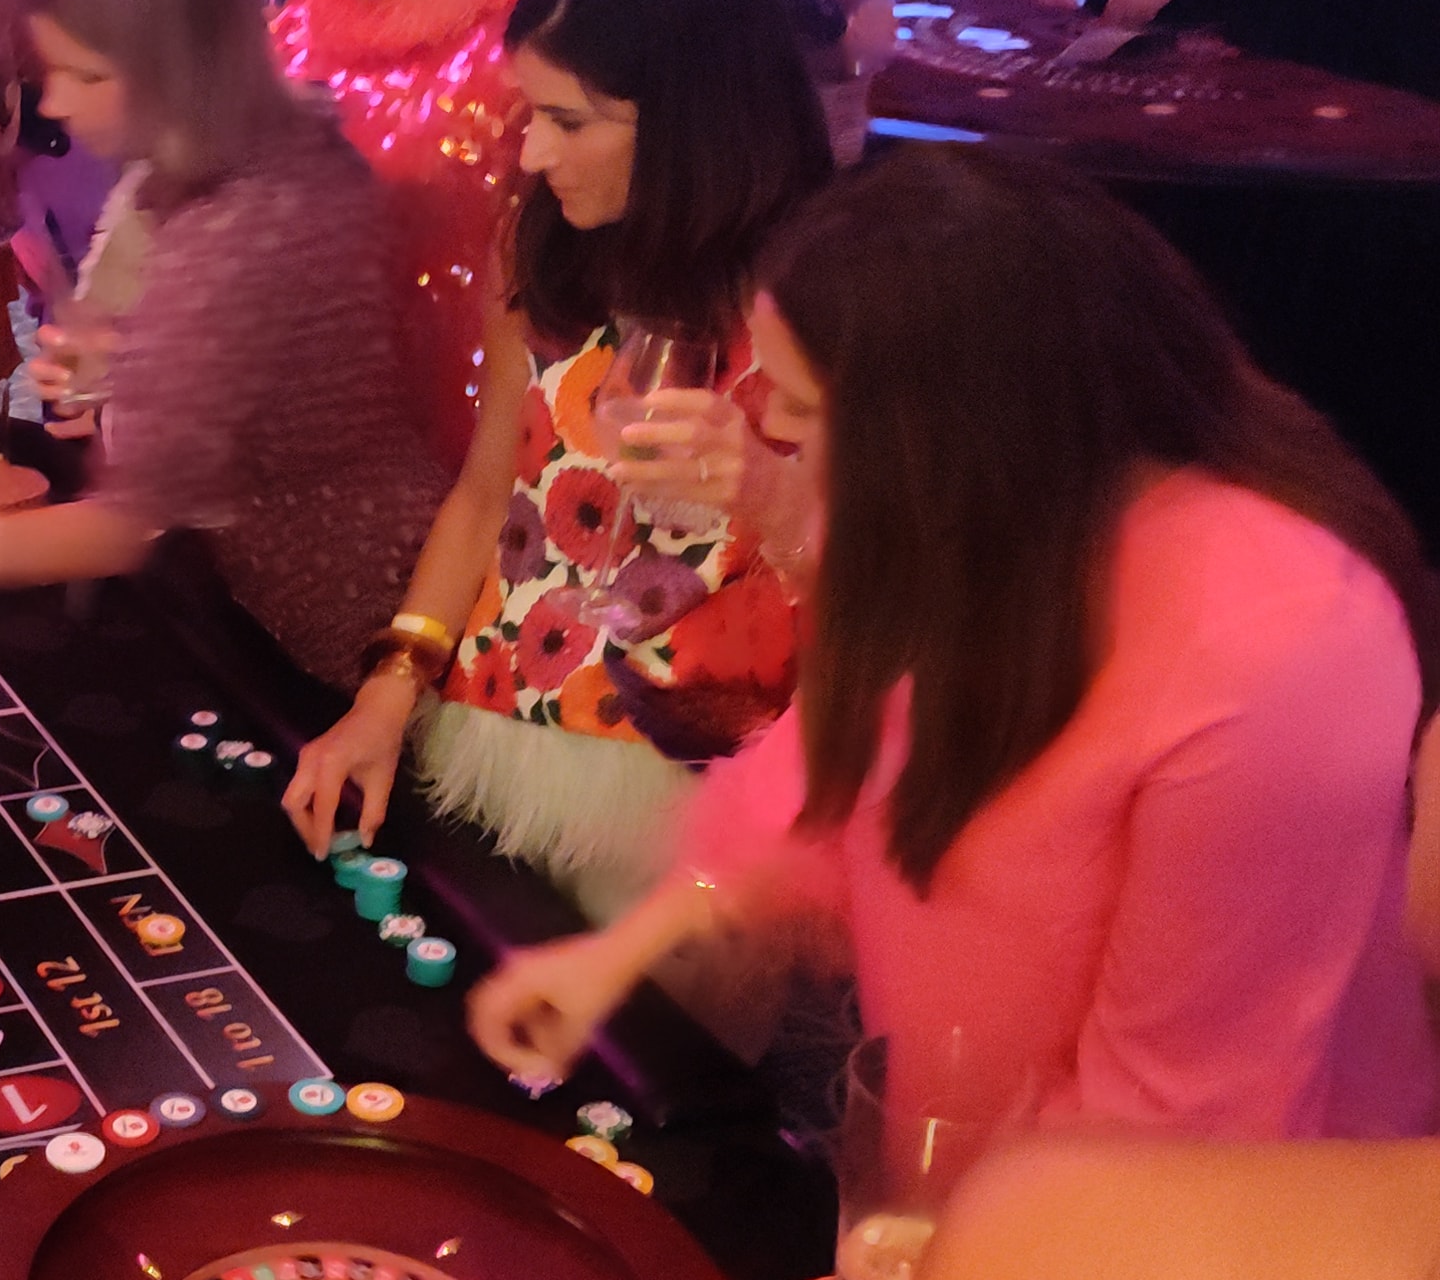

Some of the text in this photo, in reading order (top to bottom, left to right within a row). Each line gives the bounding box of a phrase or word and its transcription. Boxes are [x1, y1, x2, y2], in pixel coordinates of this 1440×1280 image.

[36, 955, 120, 1038] 1st 12
[184, 987, 233, 1019] 18
[222, 1022, 262, 1051] to
[0, 1084, 47, 1122] 1
